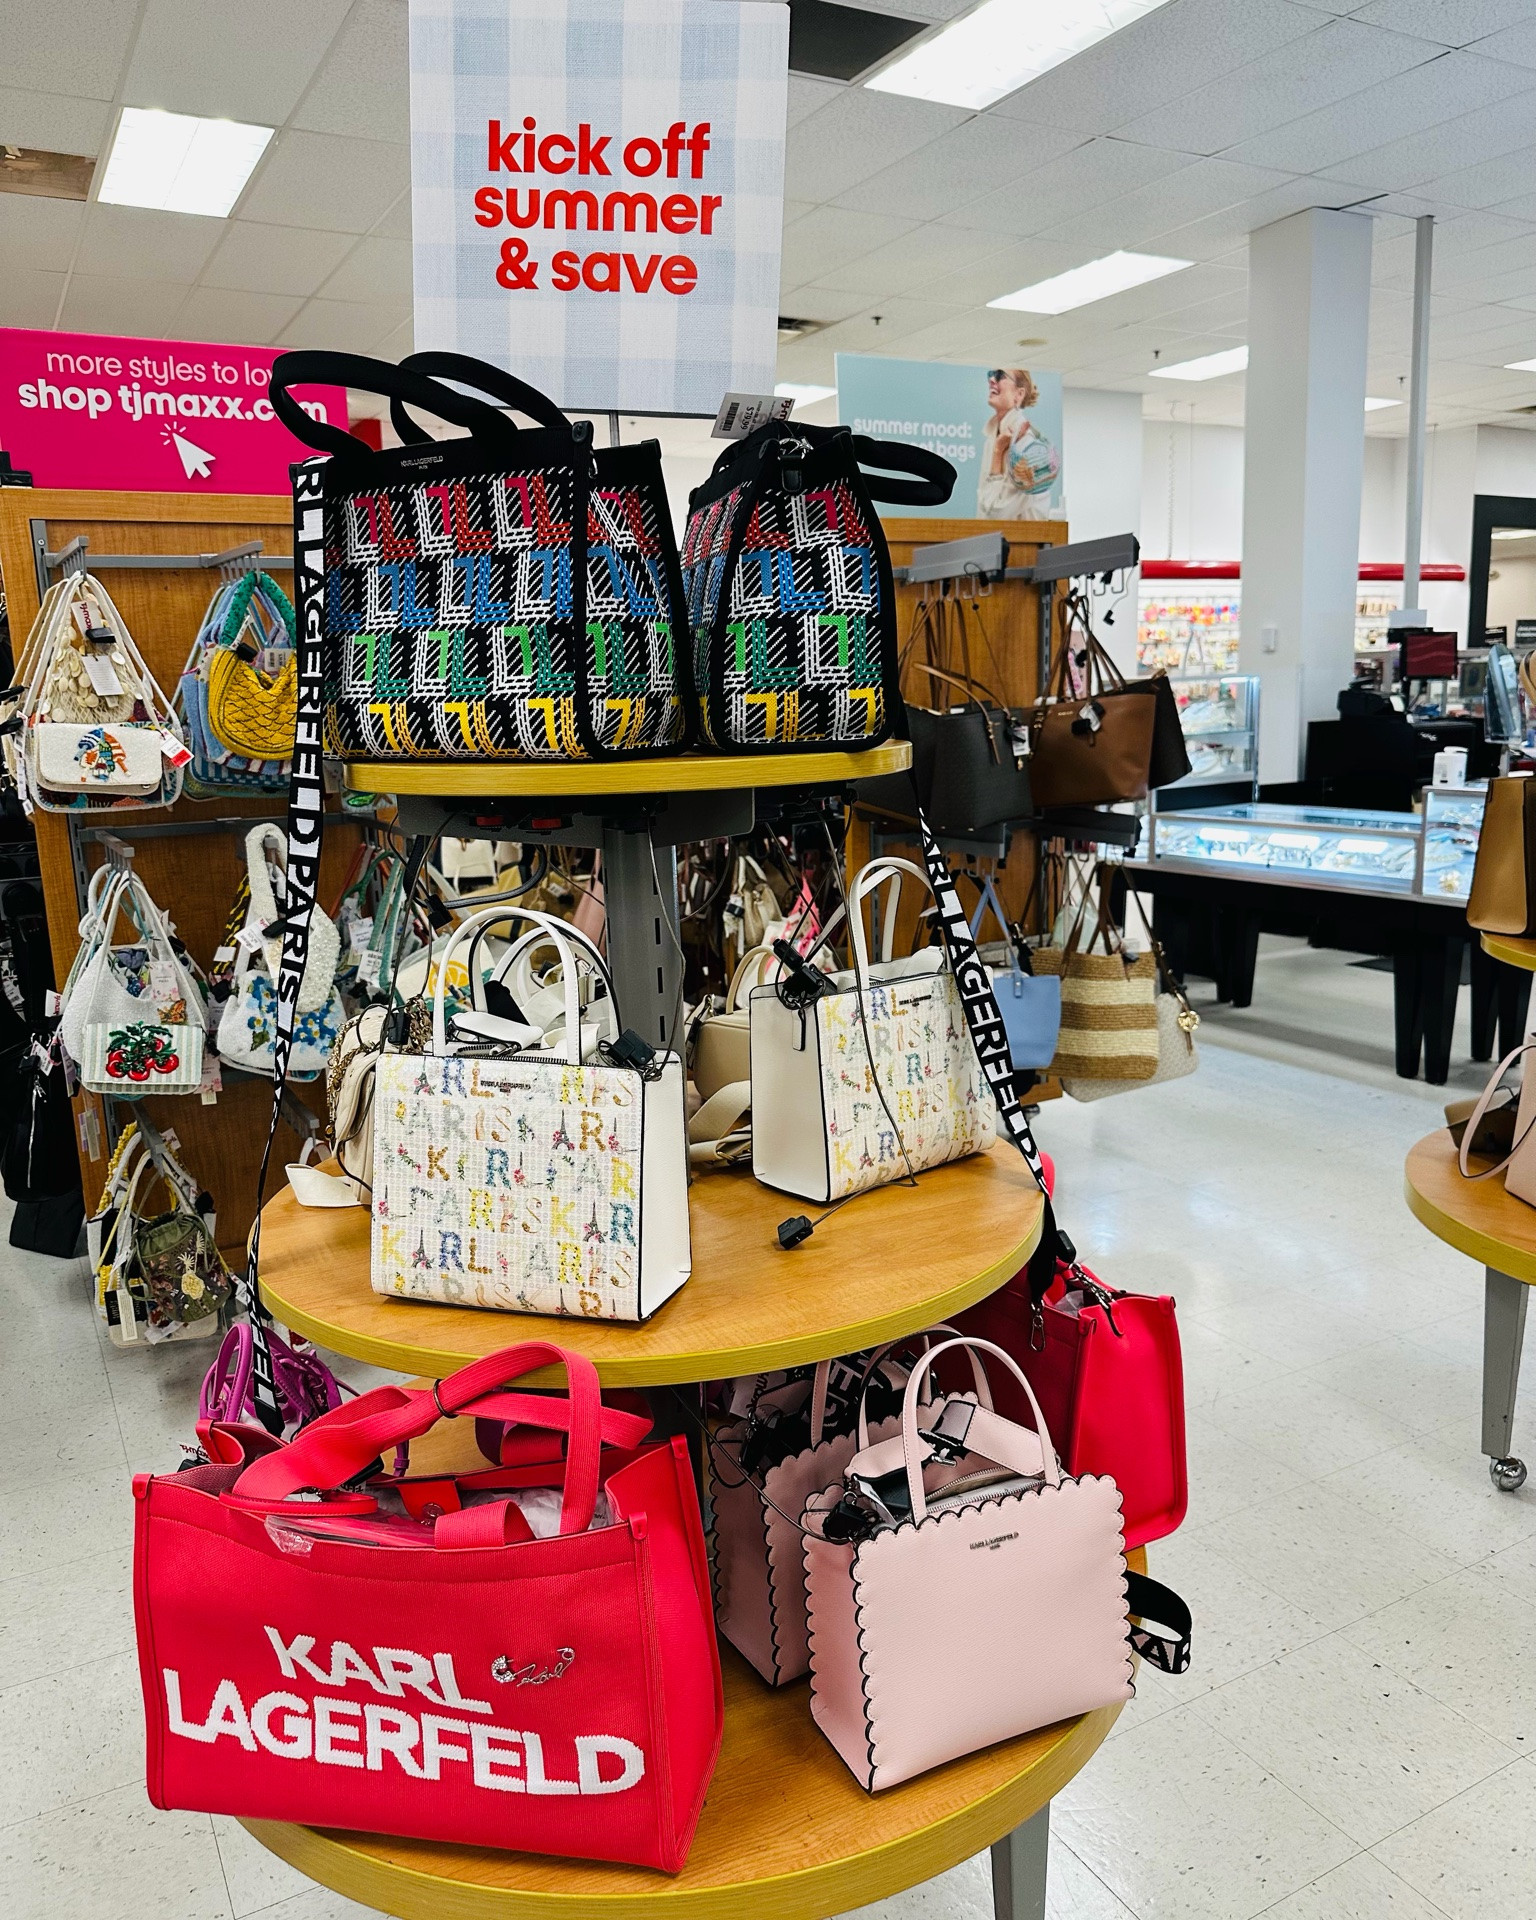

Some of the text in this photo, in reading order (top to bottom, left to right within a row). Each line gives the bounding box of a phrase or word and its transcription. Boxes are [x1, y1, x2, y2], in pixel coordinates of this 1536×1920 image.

[489, 117, 711, 179] kick off
[475, 187, 722, 235] summer
[496, 238, 698, 294] & save
[47, 353, 274, 387] more styles to lo
[18, 379, 327, 423] shop tjmaxx.cm
[853, 418, 972, 438] summer mood:
[936, 440, 976, 463] bags
[288, 546, 324, 853] LAGERFELD
[278, 857, 317, 1004] PARIS
[945, 918, 1042, 1170] LAGERFELD
[264, 1625, 494, 1715] KARL
[163, 1668, 646, 1797] LAGERFELD
